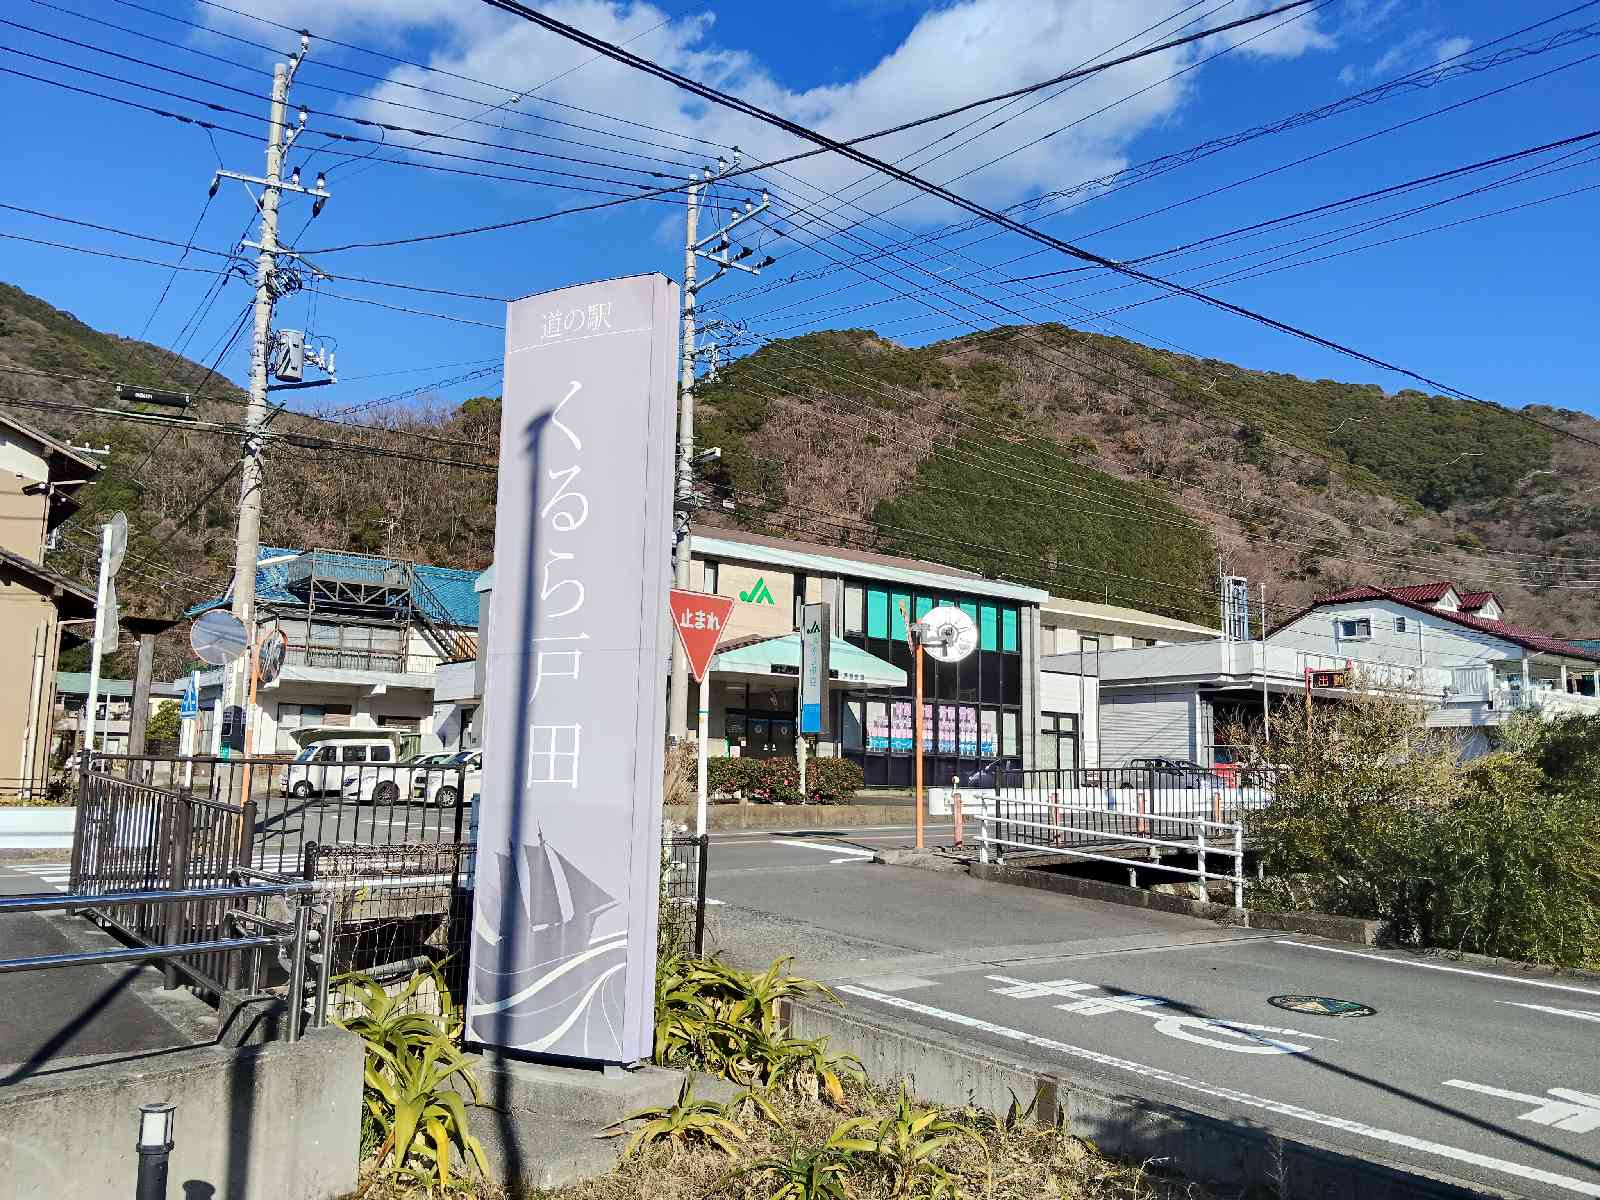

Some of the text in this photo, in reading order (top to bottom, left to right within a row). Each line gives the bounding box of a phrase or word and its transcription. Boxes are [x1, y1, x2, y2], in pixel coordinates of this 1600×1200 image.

[541, 302, 613, 339] 道の駅
[527, 380, 590, 790] くるら戸田
[739, 576, 775, 606] JA
[679, 608, 721, 632] 止まれ
